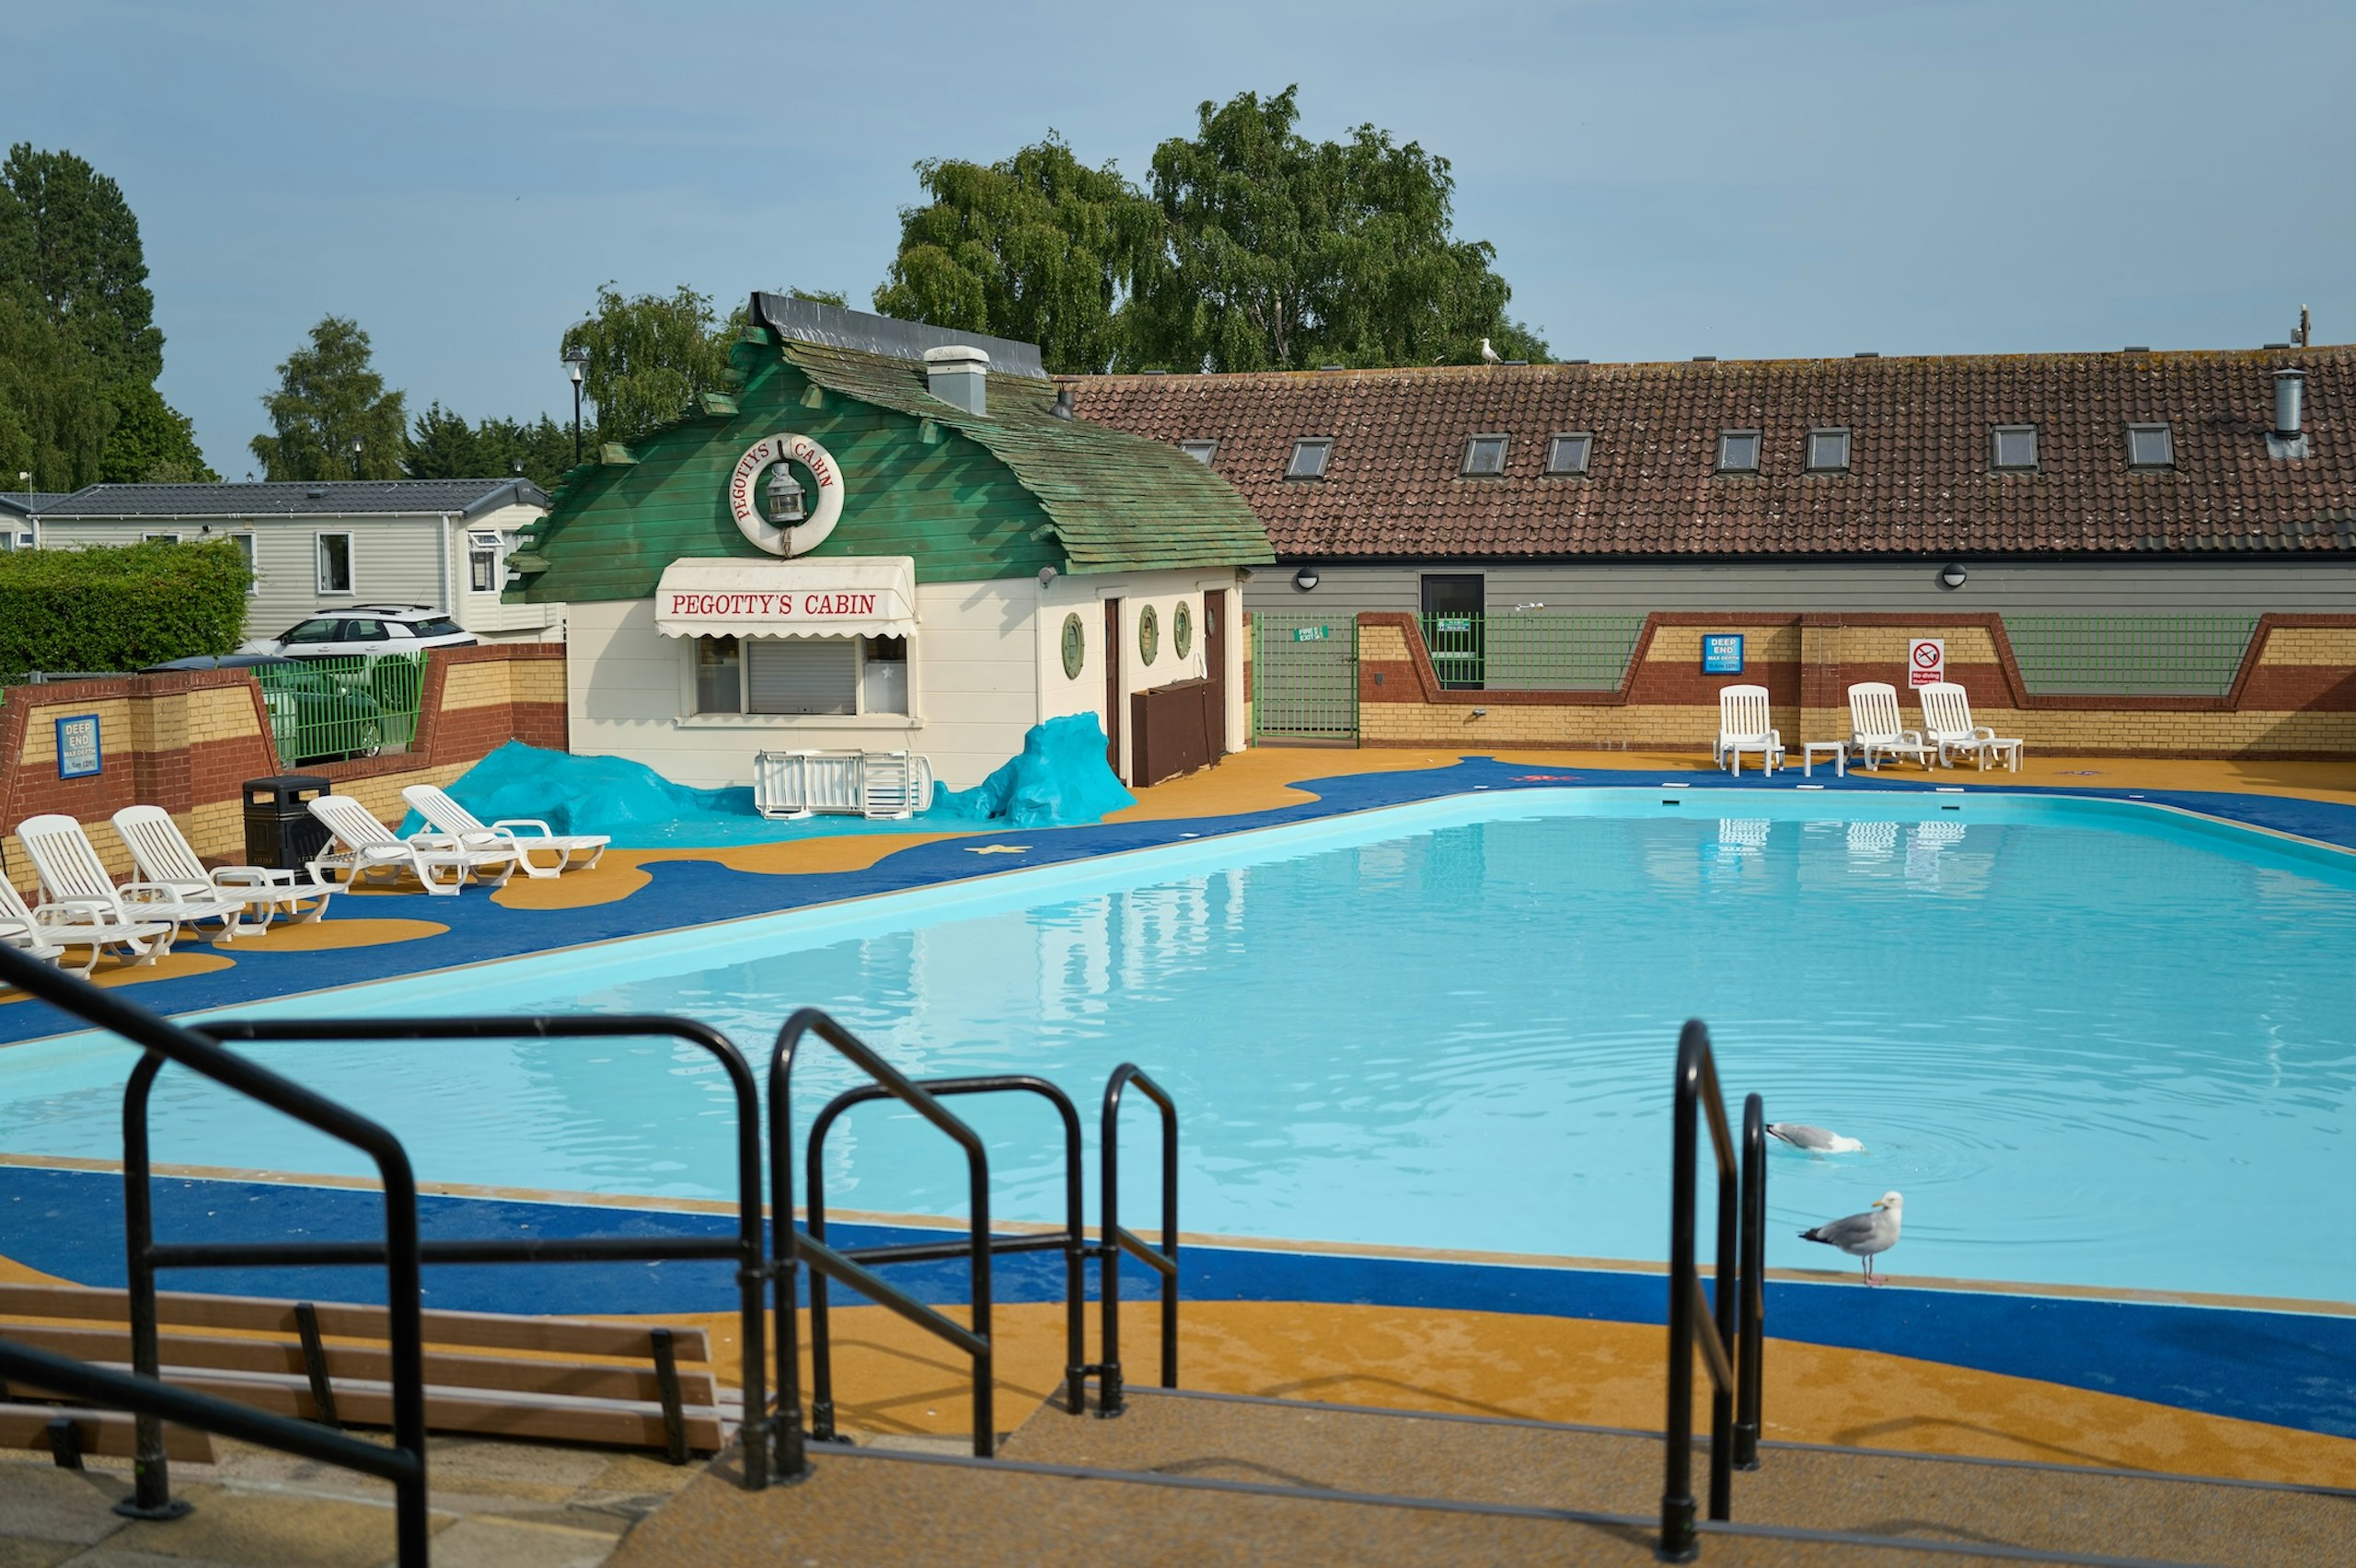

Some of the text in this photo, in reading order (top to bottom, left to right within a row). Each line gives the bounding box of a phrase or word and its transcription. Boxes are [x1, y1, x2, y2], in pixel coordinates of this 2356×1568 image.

[733, 443, 834, 521] PEGOTTYS CABIN
[671, 594, 876, 615] PEGOTTY'S CABIN
[1711, 638, 1737, 646] DEEP
[1714, 646, 1734, 654] END
[65, 722, 91, 735] DEEP
[69, 735, 89, 747] END
